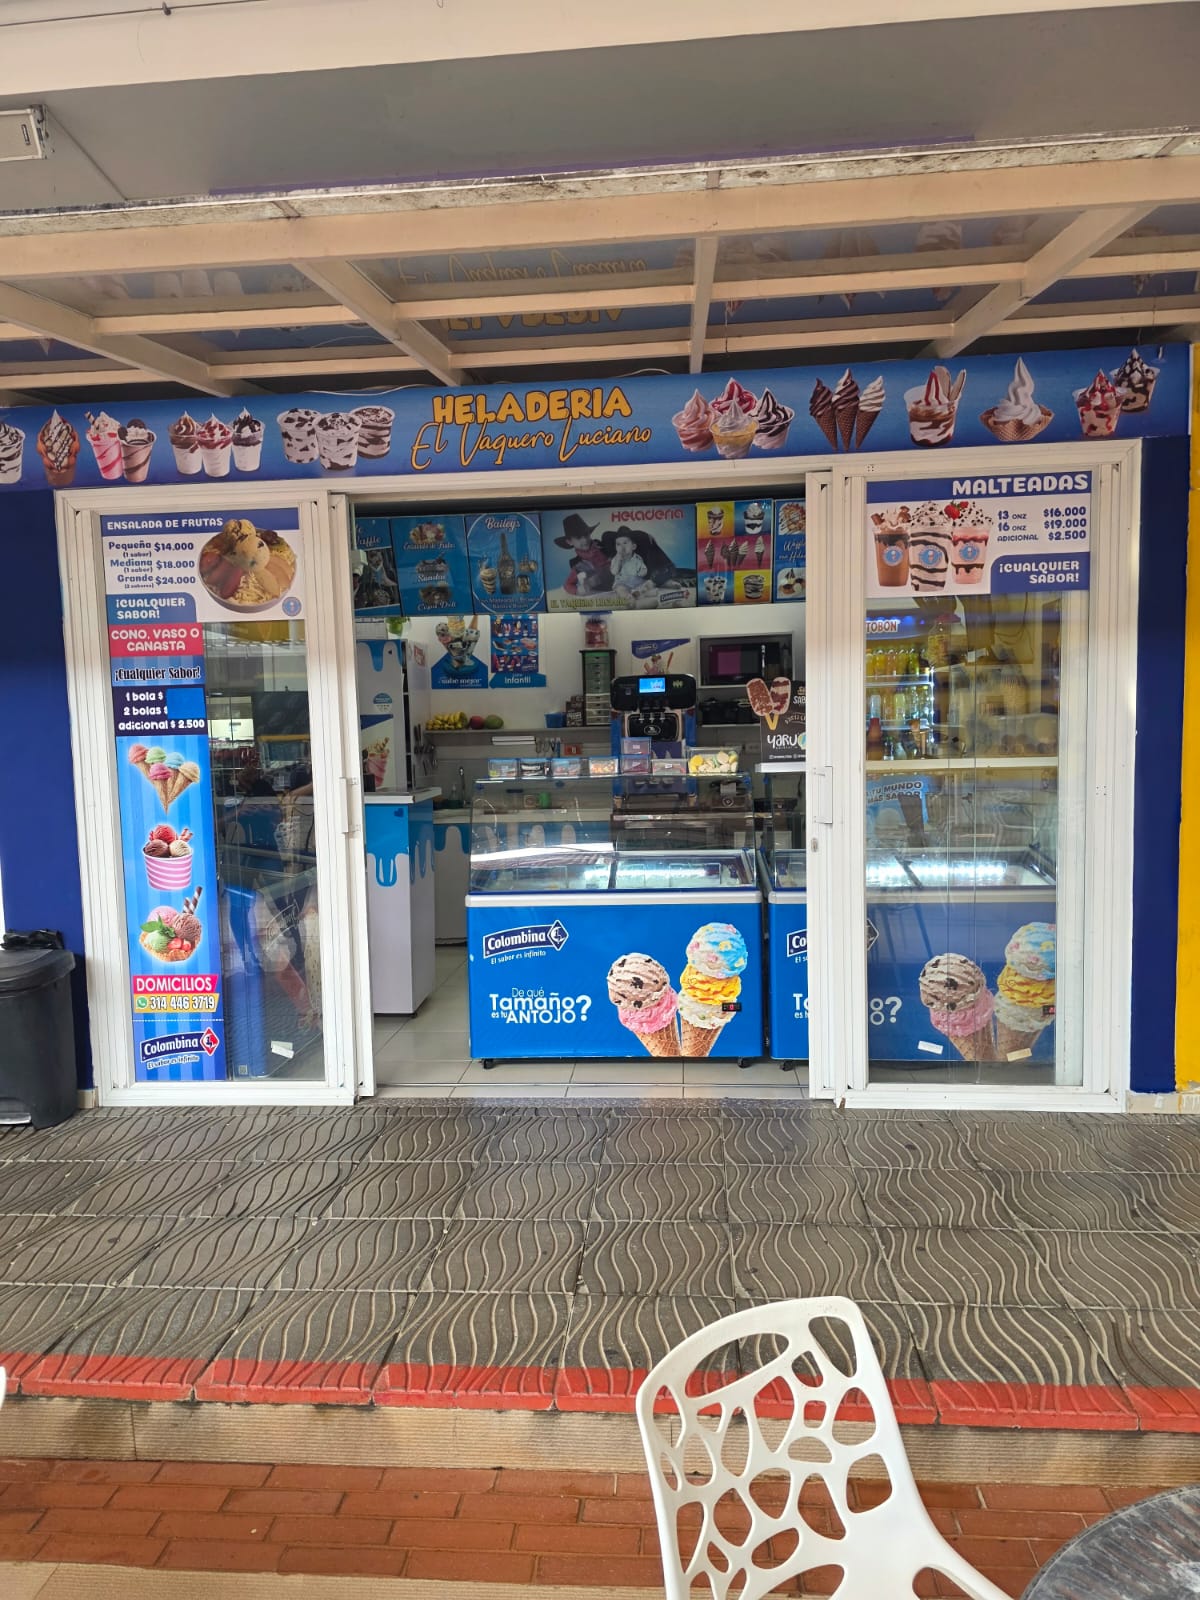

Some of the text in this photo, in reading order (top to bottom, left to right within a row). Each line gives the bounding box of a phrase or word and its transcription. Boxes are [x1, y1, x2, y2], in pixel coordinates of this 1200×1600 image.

[433, 386, 632, 425] HELADERIA
[410, 415, 652, 470] El Vaquero Luciano
[952, 473, 1089, 496] MALTEADAS
[998, 510, 1009, 520] 13
[1044, 506, 1086, 518] $16.000
[107, 517, 223, 530] ENSALADA DE FRUTAS
[998, 522, 1010, 532] 16
[1044, 518, 1087, 530] $19.000
[997, 530, 1086, 542] ADICIONAL $2.500
[108, 540, 194, 552] Pequeña $14.000
[110, 559, 195, 570] Mediana $18.000
[1000, 560, 1080, 574] ¡CUALQUIER
[117, 574, 196, 585] Grande $24.000
[1029, 574, 1079, 584] SABOR!
[116, 598, 186, 608] ¡CUALQUIER
[117, 610, 160, 620] SABOR!
[866, 621, 897, 632] TOBON
[111, 628, 200, 640] CONO, VASO O
[126, 641, 186, 652] CANASTA
[115, 666, 201, 682] ¡Cualquier Sabor!
[126, 691, 164, 701] 1 bola $
[793, 696, 806, 704] SAB
[124, 706, 130, 716] 2
[132, 706, 162, 716] bolas
[118, 720, 205, 730] adicional $ 2.500
[884, 781, 922, 792] MUNDO
[488, 930, 546, 950] Colombina
[498, 954, 514, 963] sabor
[524, 950, 546, 959] infinito
[136, 979, 212, 992] DOMICILIOS
[512, 986, 544, 1000] De qué
[150, 995, 215, 1010] 314 446 3719
[144, 1036, 198, 1056] Colombina
